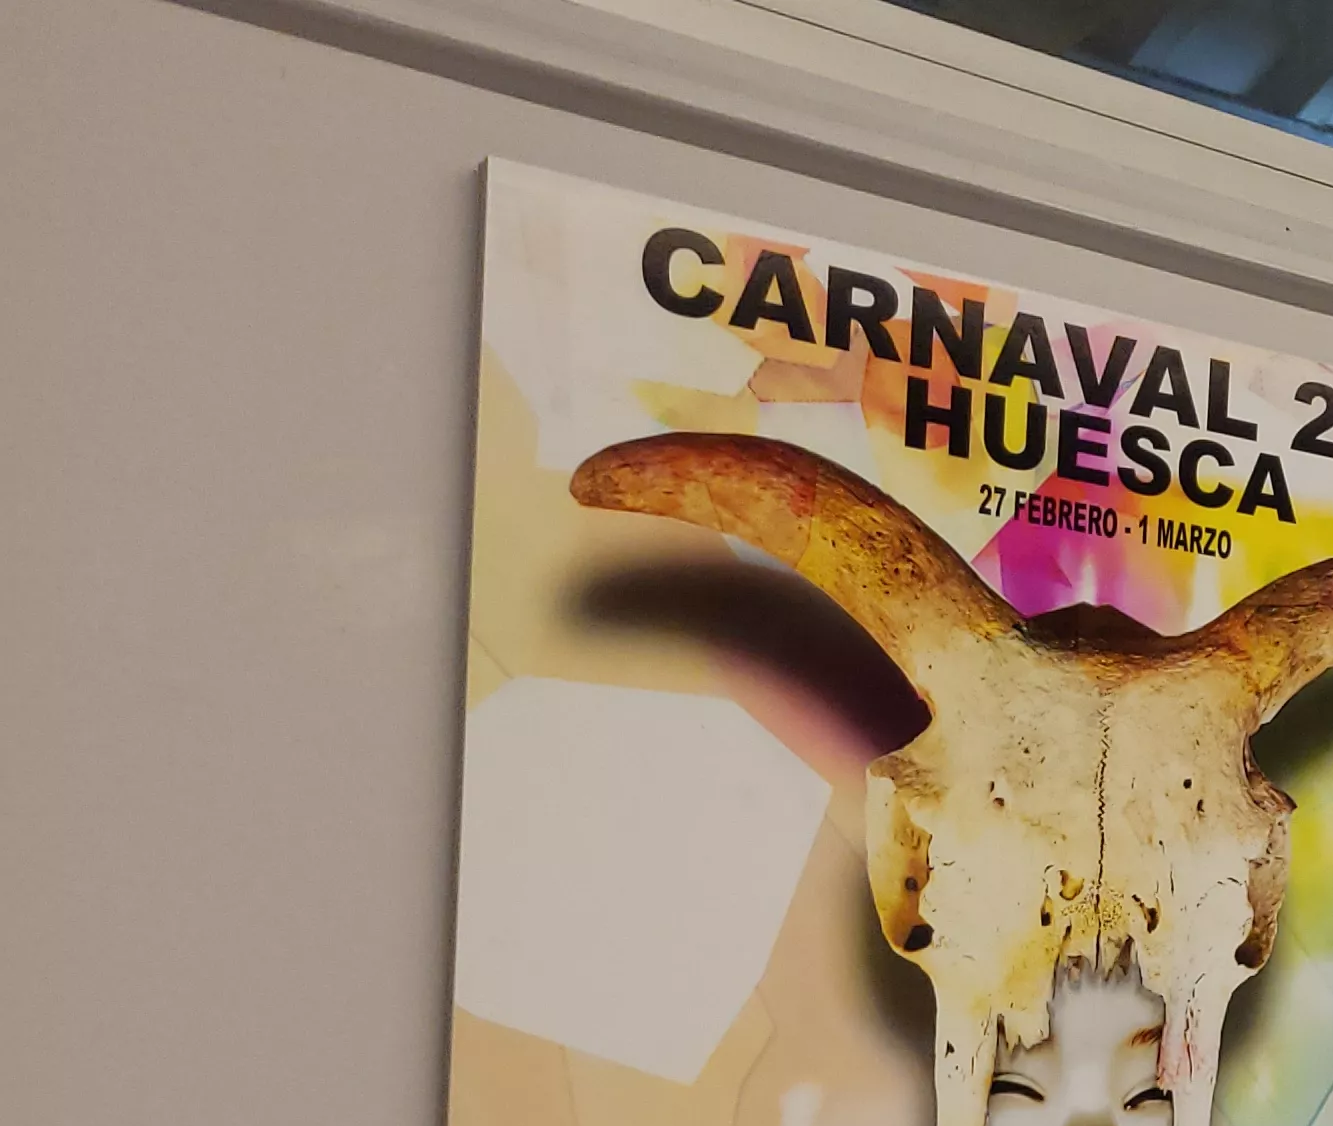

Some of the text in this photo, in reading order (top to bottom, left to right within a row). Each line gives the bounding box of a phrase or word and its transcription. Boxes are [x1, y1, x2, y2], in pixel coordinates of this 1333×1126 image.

[642, 227, 1258, 440] CARNAVAL
[904, 378, 1297, 523] HUESCA
[978, 484, 1006, 517] 27
[1014, 491, 1118, 539] FEBRERO
[1139, 515, 1149, 545] 1
[1157, 517, 1232, 560] MARZO
